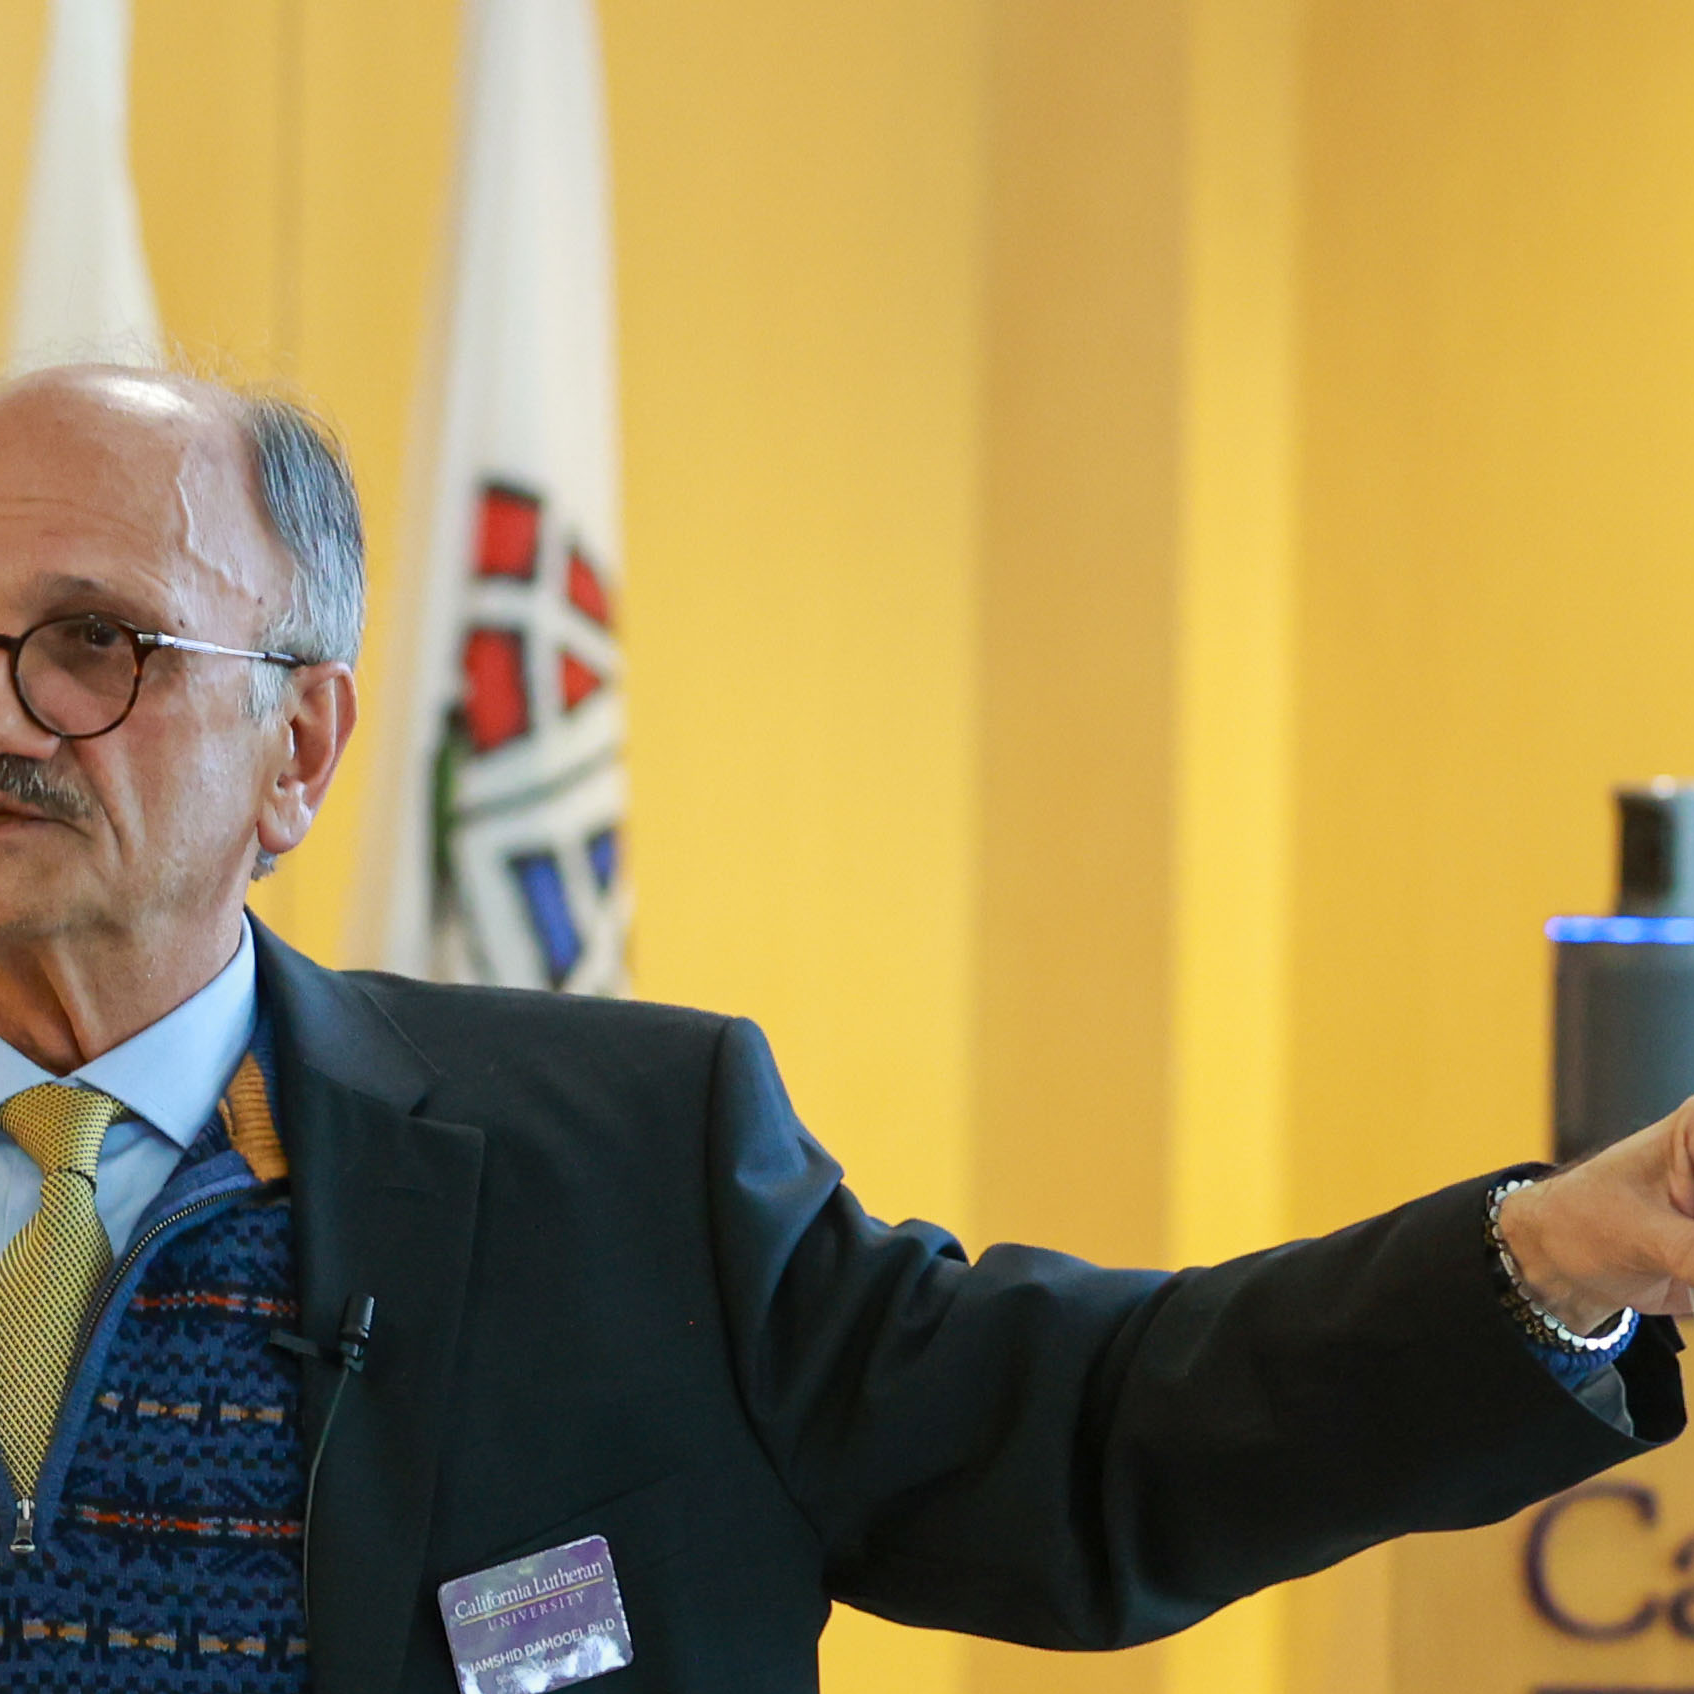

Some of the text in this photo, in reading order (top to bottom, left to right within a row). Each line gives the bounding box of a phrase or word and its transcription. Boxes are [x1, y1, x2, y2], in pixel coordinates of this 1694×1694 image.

[454, 1561, 604, 1620] California Lutheran
[487, 1591, 585, 1632] UNIVERSITY
